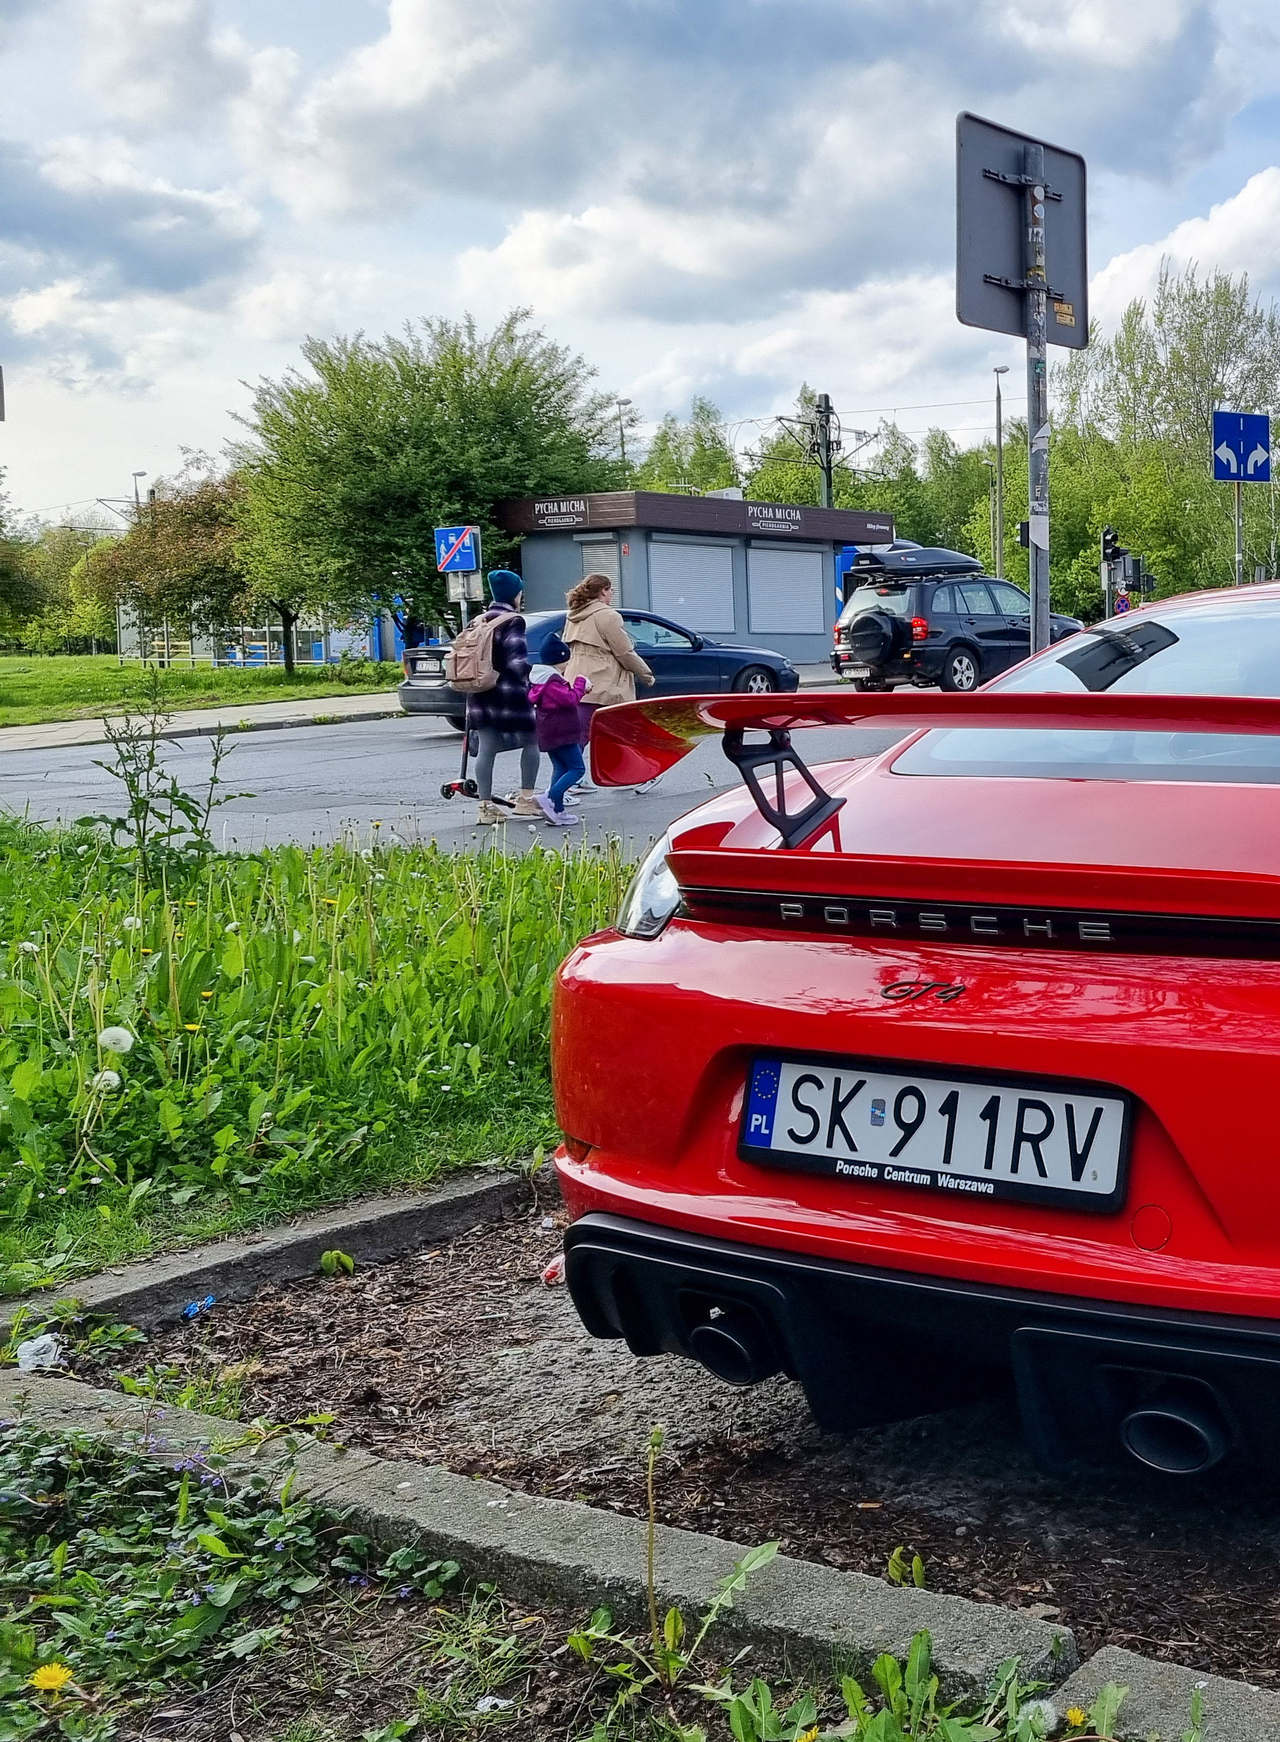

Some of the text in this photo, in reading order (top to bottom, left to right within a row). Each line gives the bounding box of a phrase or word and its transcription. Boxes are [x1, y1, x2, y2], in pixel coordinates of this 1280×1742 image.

[534, 500, 585, 514] PYCHA MICHA
[748, 506, 801, 520] PYCHA MICHA
[780, 903, 1112, 940] PORSCHE
[880, 980, 966, 1002] GT4
[750, 1114, 769, 1134] PL
[787, 1074, 1104, 1182] SK 911RV
[836, 1160, 994, 1194] Porsche Centrum Warszawa
